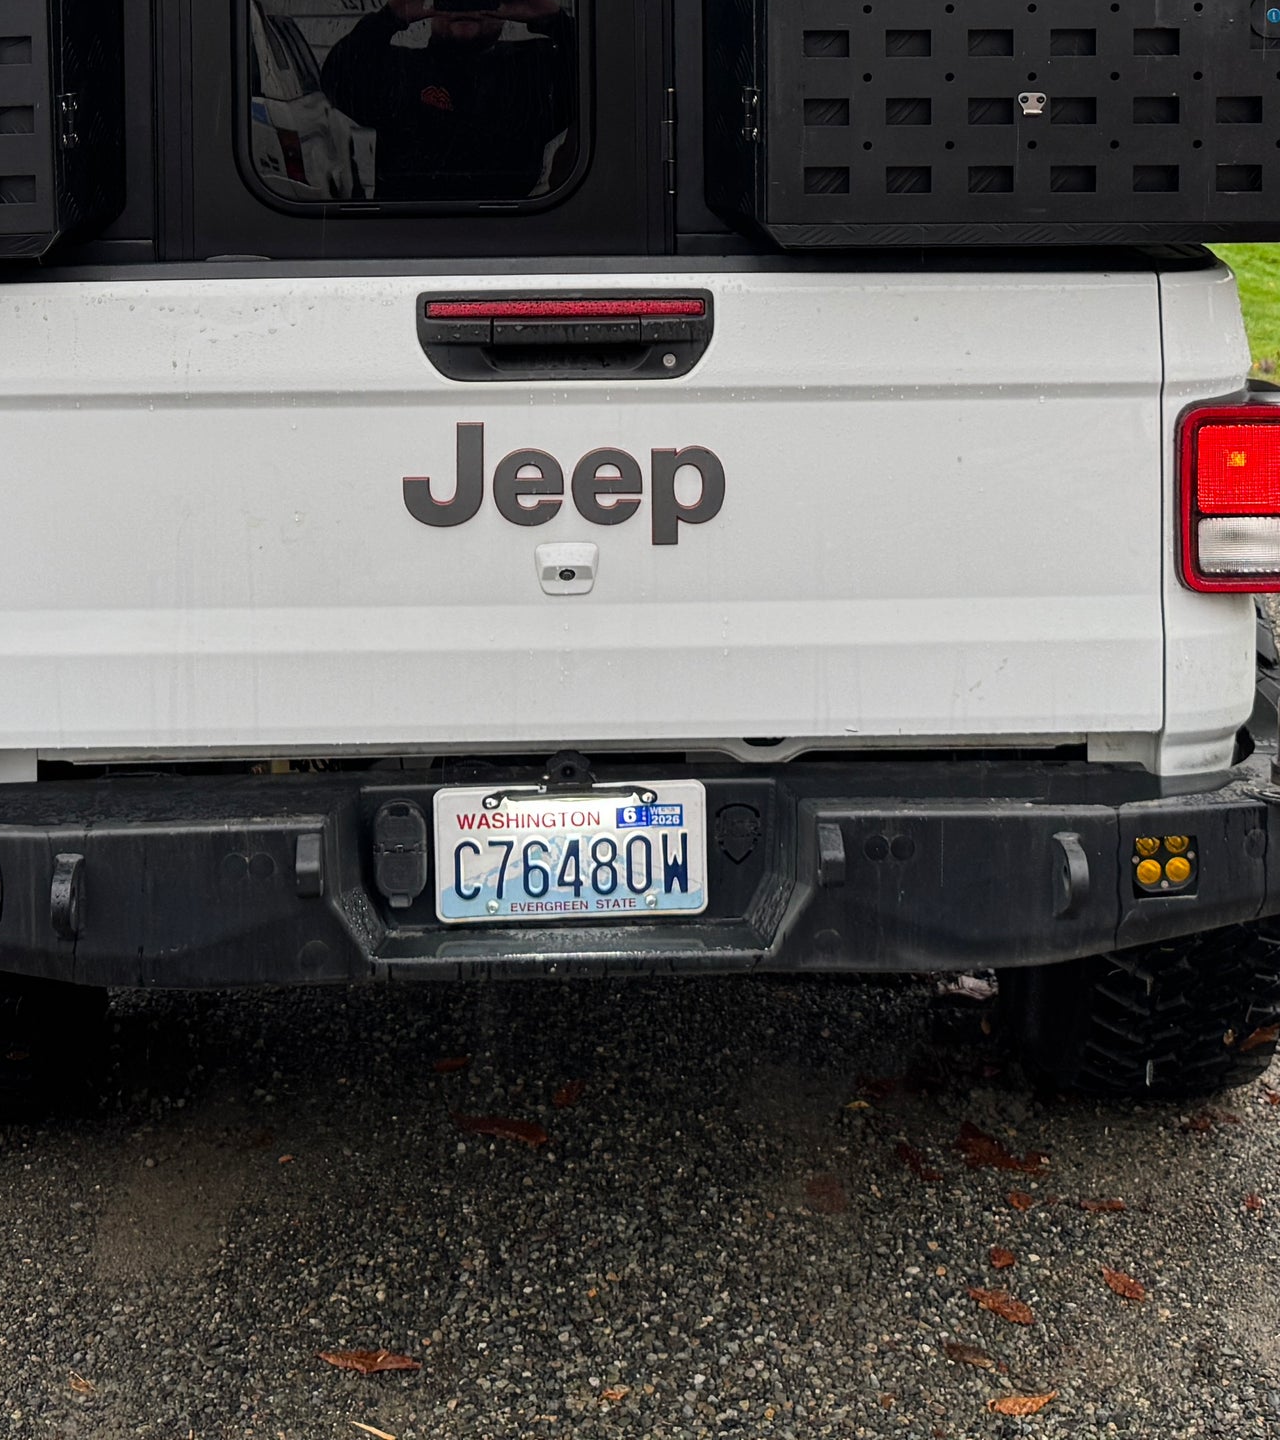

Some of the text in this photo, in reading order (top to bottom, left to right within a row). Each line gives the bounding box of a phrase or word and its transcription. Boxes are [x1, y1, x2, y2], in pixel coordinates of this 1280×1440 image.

[402, 421, 726, 545] Jeep
[457, 811, 601, 830] WASHINGTON
[623, 807, 637, 823] 6
[651, 815, 680, 825] 2026
[454, 833, 689, 900] C76480W
[510, 898, 637, 912] EVERGREEN STATE
